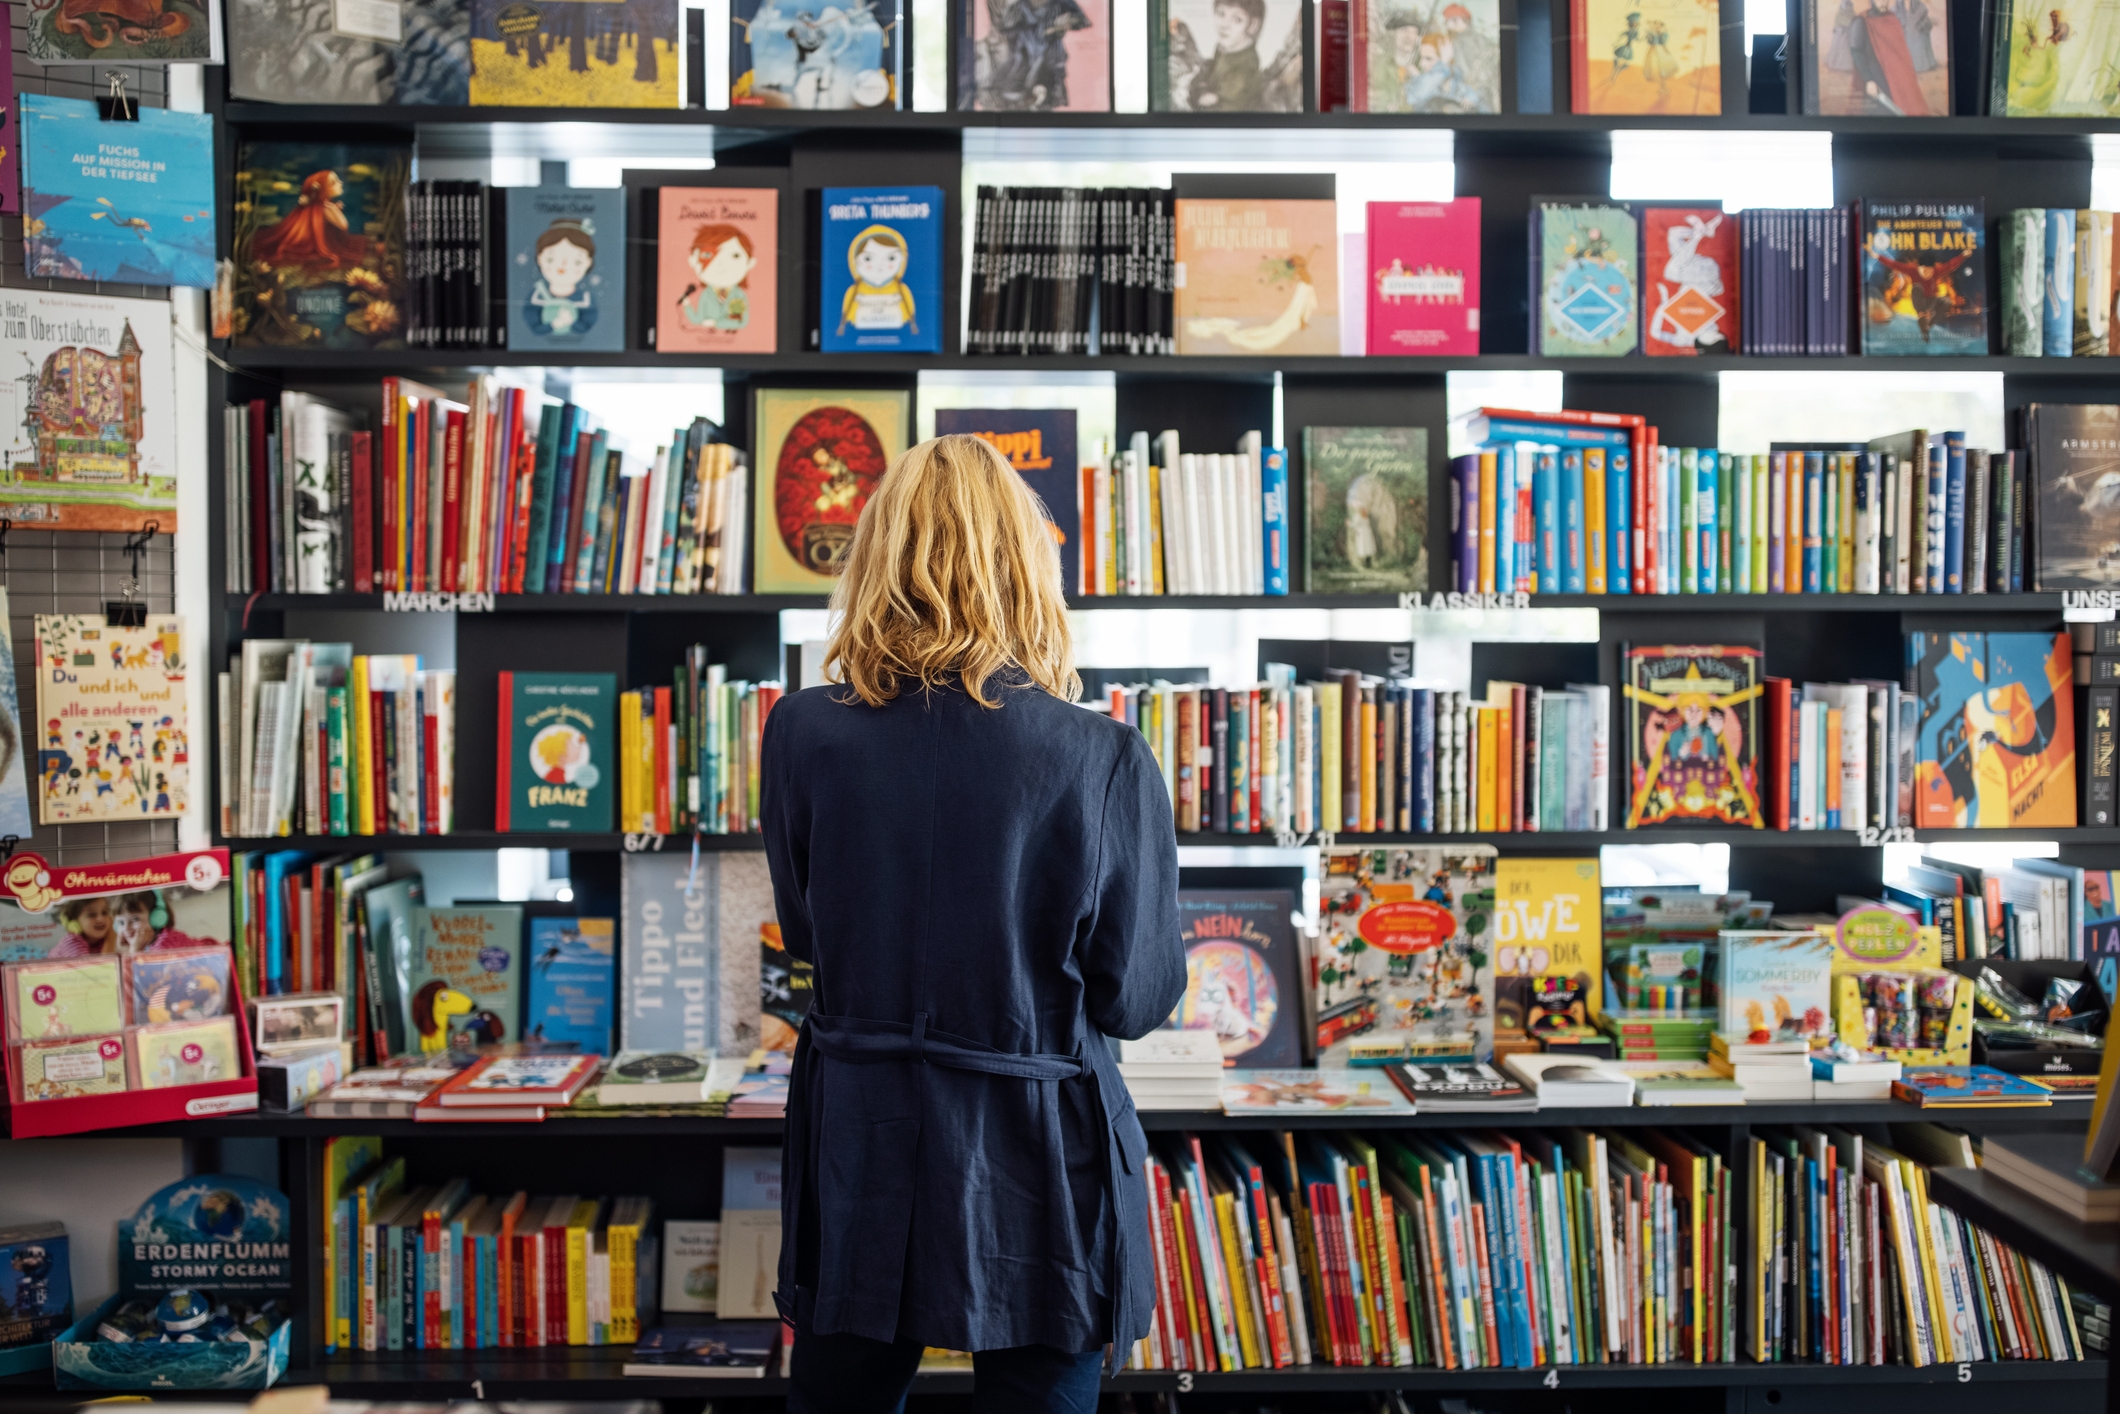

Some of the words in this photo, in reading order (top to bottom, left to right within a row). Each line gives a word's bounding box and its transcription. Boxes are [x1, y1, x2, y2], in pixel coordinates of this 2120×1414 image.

[98, 143, 140, 158] FUCHS
[72, 153, 96, 165] AUF
[98, 156, 150, 171] MISSION
[152, 161, 166, 172] IN
[81, 166, 107, 178] DER
[109, 168, 157, 183] TIEFSEE
[1871, 204, 1912, 217] PHILIP
[1915, 204, 1975, 217] PULLMAN
[1877, 220, 1891, 229] DIE
[1894, 220, 1943, 230] ABENTEUER
[1945, 220, 1962, 229] VON
[1867, 232, 1916, 251] JOHN
[1919, 231, 1977, 250] BLAKE
[6, 300, 28, 318] Hotel
[4, 320, 27, 340] zum
[31, 314, 112, 346] Oberstübchen
[1398, 591, 1531, 610] KLASSIKER
[52, 669, 78, 683] Du
[79, 679, 111, 694] und
[114, 678, 139, 693] ich
[140, 687, 171, 701] und
[60, 702, 89, 718] alle
[93, 701, 158, 718] anderen
[2011, 753, 2039, 791] ELSA
[527, 785, 589, 808] FRANZ
[2013, 781, 2045, 822] NACHT
[624, 834, 666, 852] 6/7
[1856, 828, 1915, 847] 12/13
[64, 868, 172, 888] Ohrwürmchen
[1510, 880, 1532, 895] DER
[1495, 893, 1580, 942] ÖWE
[1853, 923, 1895, 936] HOLZ
[1553, 942, 1583, 965] DIR
[1849, 937, 1906, 951] PERLEN
[633, 900, 671, 1019] Tippo
[1735, 968, 1823, 984] SOMMERBY
[134, 1242, 289, 1261] ERDENFLUMM
[151, 1264, 219, 1278] STORMY
[222, 1263, 281, 1277] OCEAN
[1543, 1369, 1560, 1389] 4
[1957, 1363, 1972, 1382] 5
[472, 1380, 484, 1399] 1
[1177, 1373, 1194, 1392] 3
